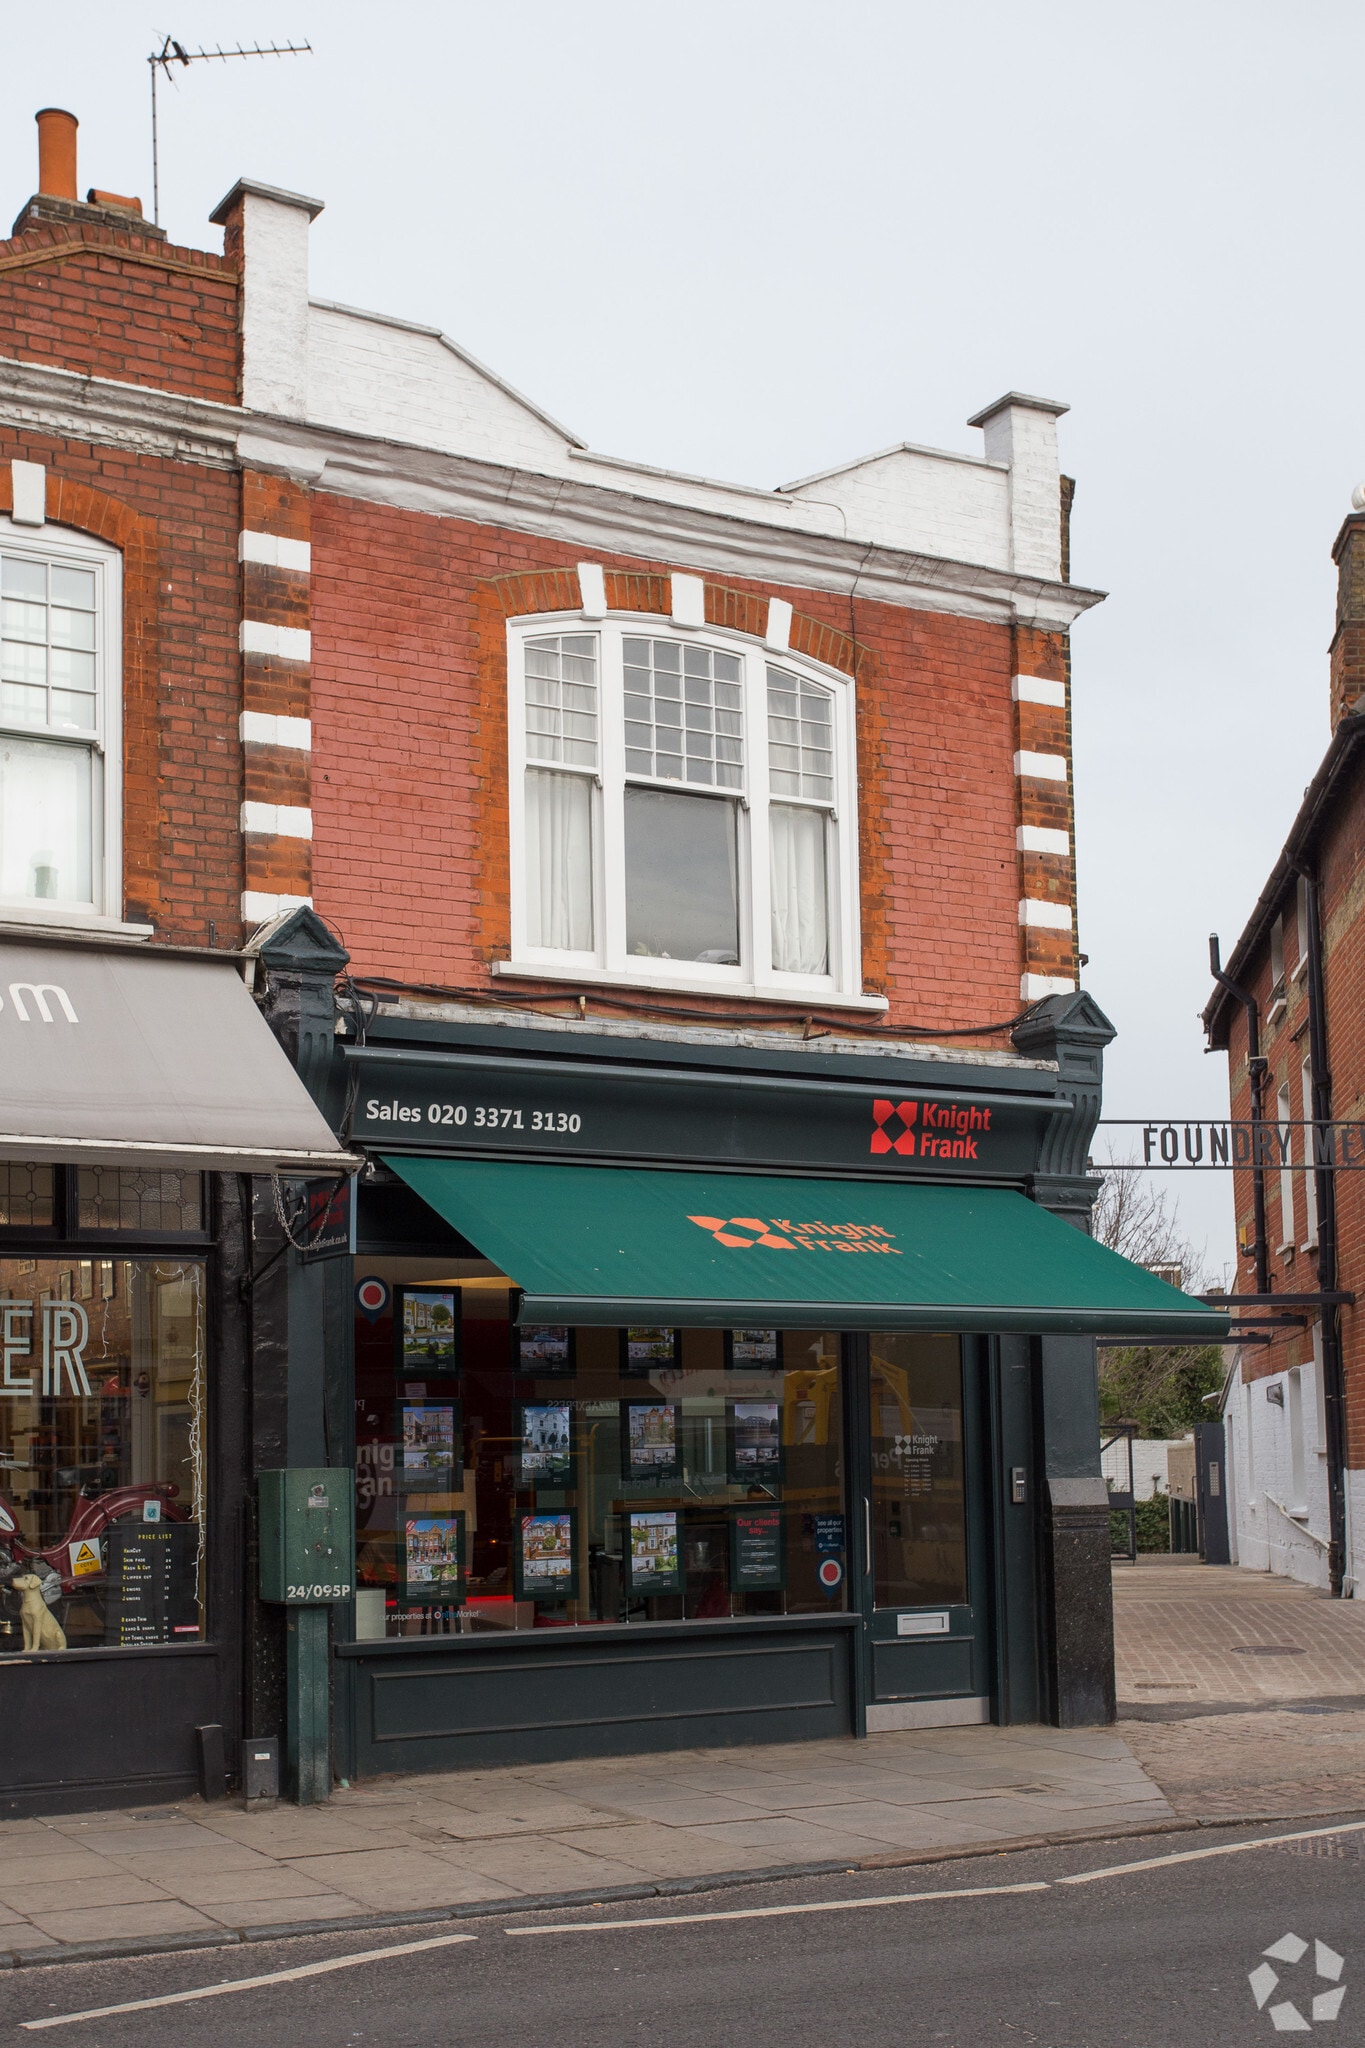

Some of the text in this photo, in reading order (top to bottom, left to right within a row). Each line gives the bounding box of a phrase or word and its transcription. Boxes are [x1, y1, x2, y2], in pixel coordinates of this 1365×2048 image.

[0, 982, 80, 1023] m
[366, 1099, 581, 1133] Sales 020 3371 3130
[922, 1102, 992, 1136] Knight
[920, 1133, 978, 1159] Frank
[1143, 1127, 1365, 1163] FOUNDRY ME
[769, 1219, 896, 1240] Knight
[793, 1236, 904, 1254] Frank
[0, 1300, 92, 1396] ER
[912, 1435, 938, 1446] Knight
[912, 1446, 934, 1454] Frank
[737, 1518, 780, 1526] Our clients
[287, 1584, 350, 1600] 24/095P
